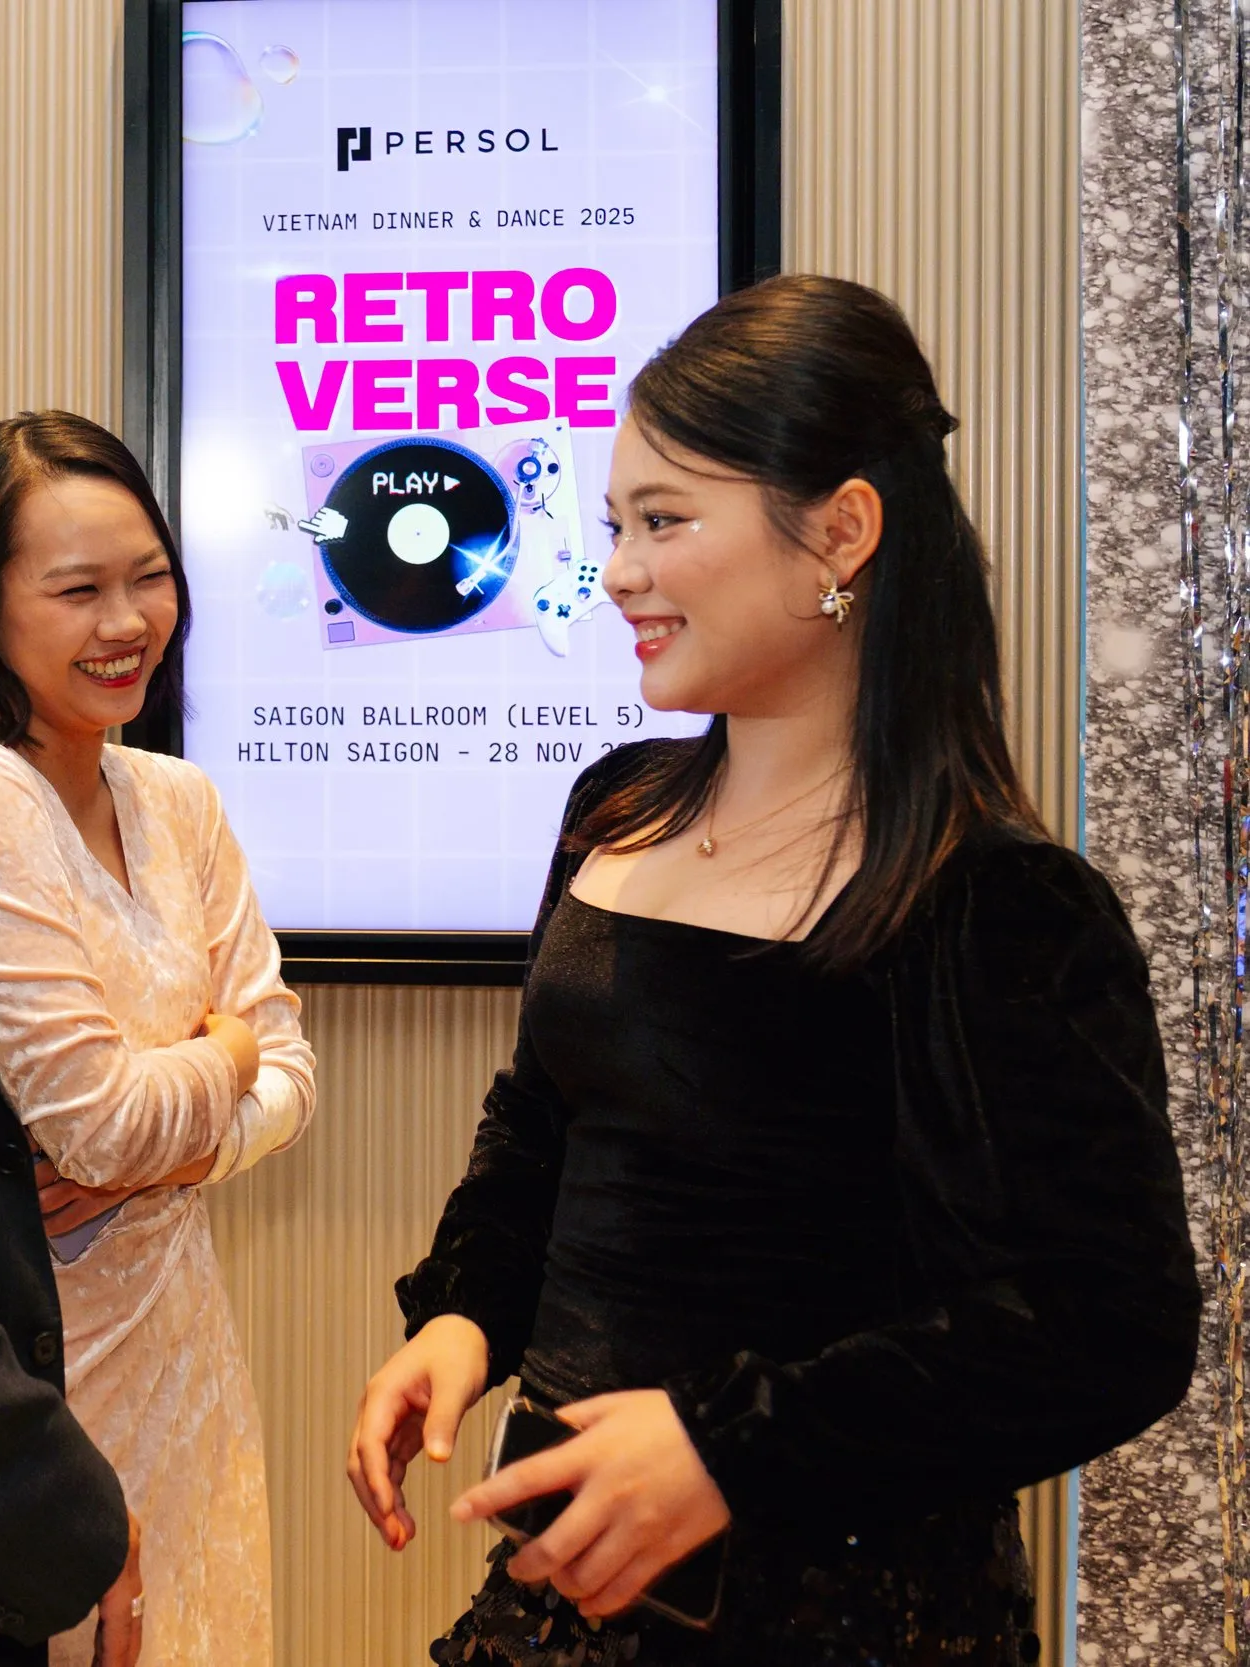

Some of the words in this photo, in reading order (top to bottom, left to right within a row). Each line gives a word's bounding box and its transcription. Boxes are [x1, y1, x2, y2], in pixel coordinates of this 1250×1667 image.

[385, 127, 559, 156] PERSOL
[262, 212, 357, 232] VIETNAM
[373, 210, 454, 230] DINNER
[468, 210, 482, 228] &
[497, 208, 565, 228] DANCE
[580, 207, 635, 226] 2025
[275, 268, 617, 345] RETRO
[275, 356, 616, 431] VERSE
[372, 471, 439, 496] PLAY
[253, 706, 345, 726] SAIGON
[363, 706, 487, 726] BALLROOM
[507, 703, 598, 728] (LEVEL
[617, 703, 644, 728] 5)
[238, 742, 329, 763] HILTON
[347, 742, 439, 763] SAIGON
[489, 742, 519, 763] 28
[537, 742, 582, 762] NOV
